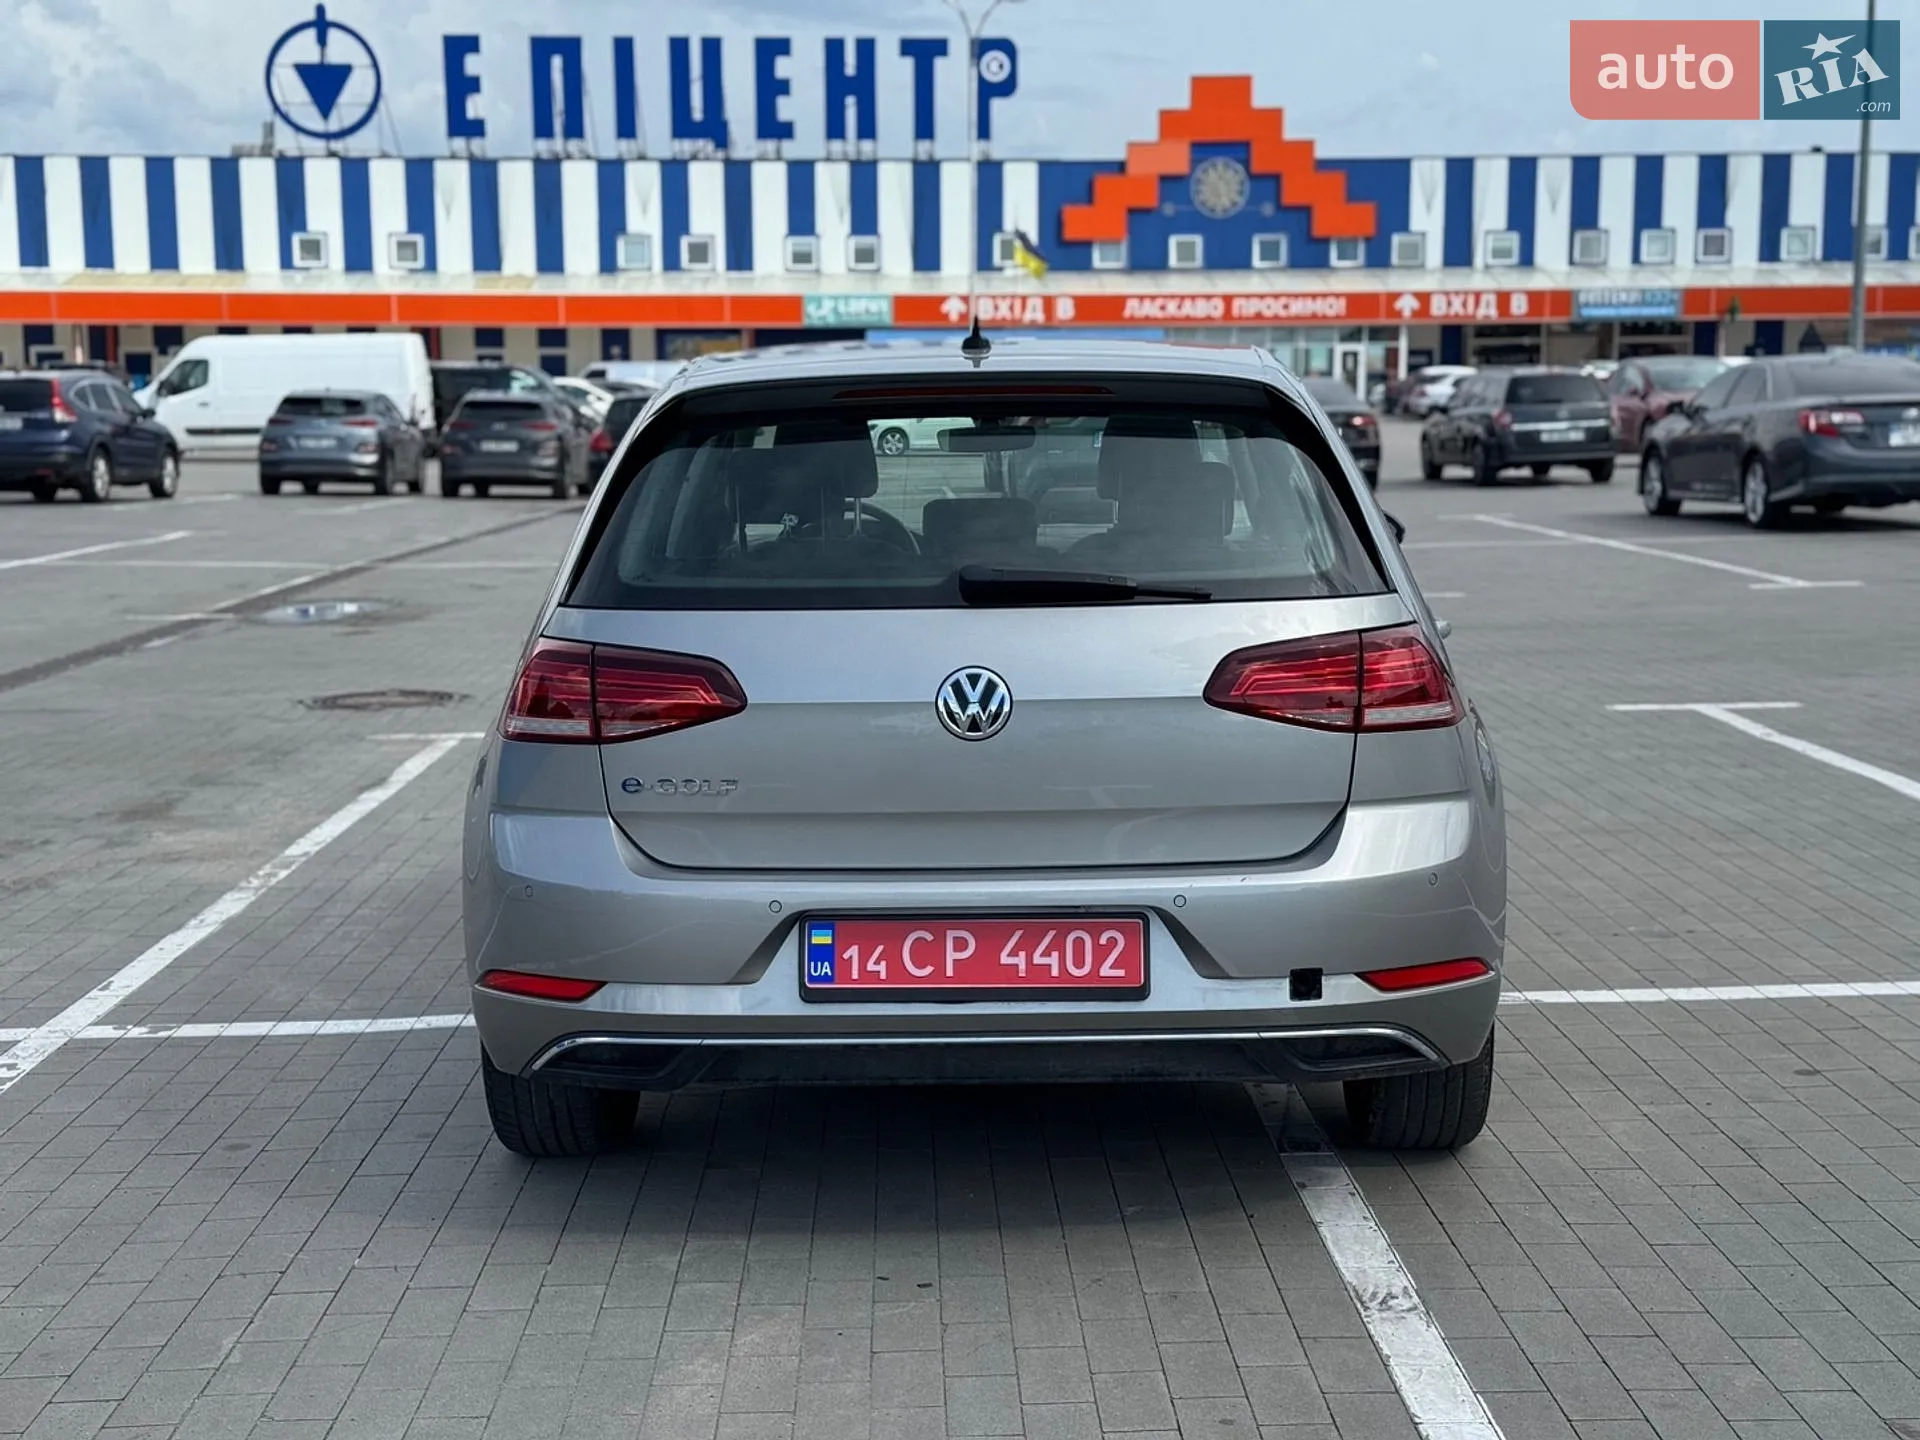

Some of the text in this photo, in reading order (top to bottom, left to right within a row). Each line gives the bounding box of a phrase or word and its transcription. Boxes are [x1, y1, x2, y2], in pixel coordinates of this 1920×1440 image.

[443, 34, 1018, 150] ЕПІЦЕНТР
[978, 295, 1045, 324] ВХІД
[1123, 296, 1225, 319] ЛАСКАВО
[1429, 292, 1499, 320] ВХІД
[938, 668, 1010, 739] VW
[810, 961, 832, 977] UA
[841, 929, 1127, 980] 14 CP 4402
